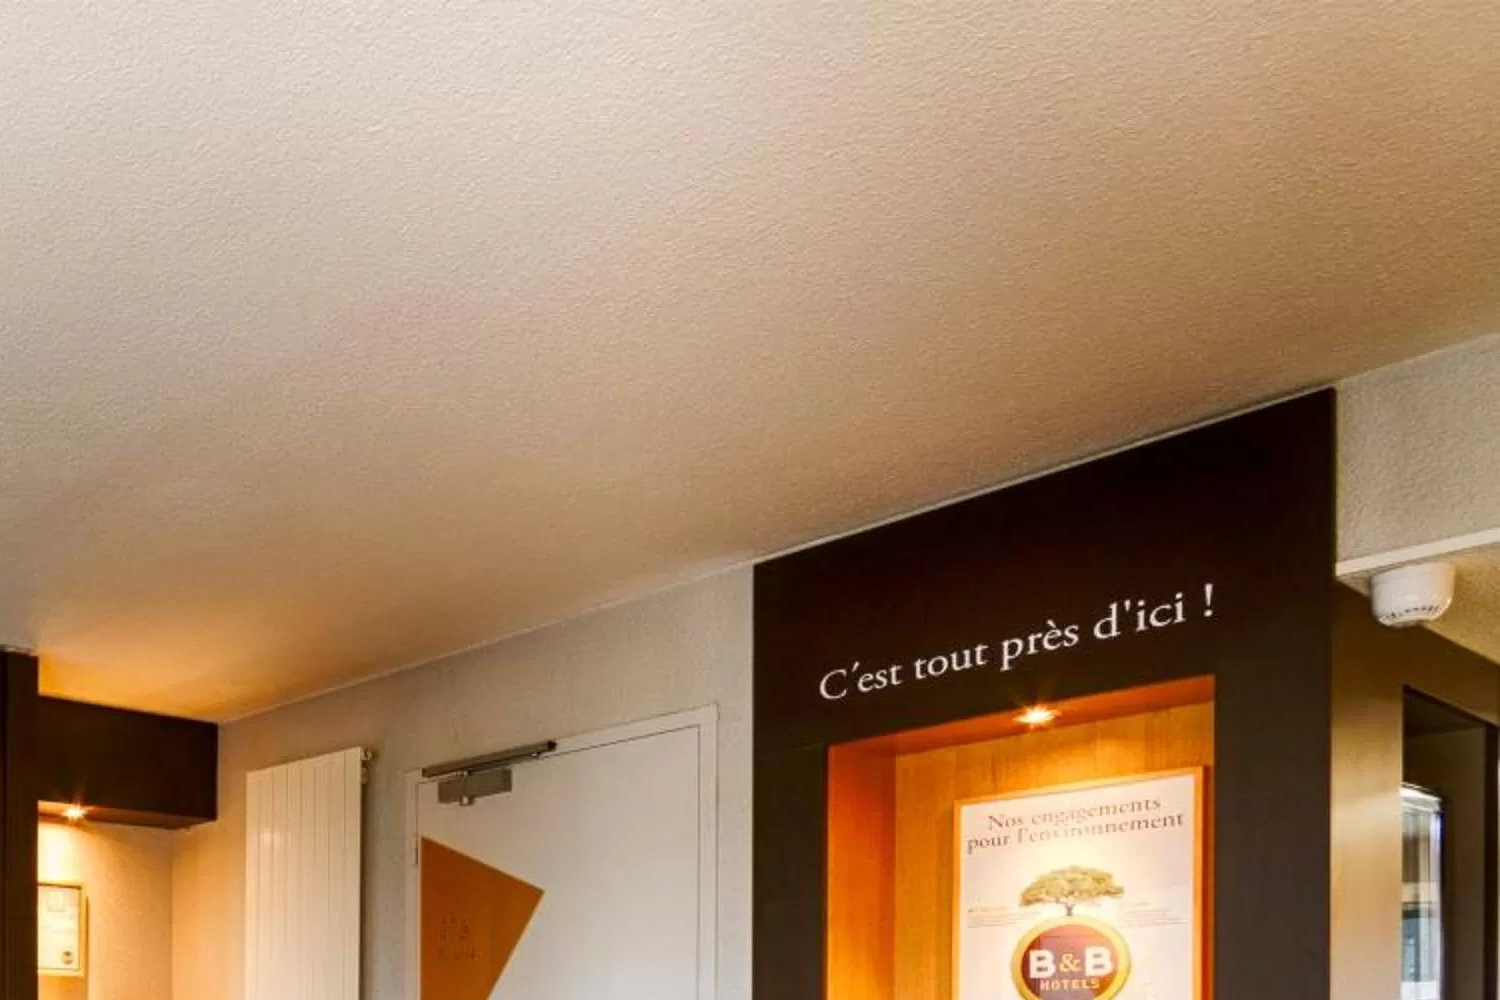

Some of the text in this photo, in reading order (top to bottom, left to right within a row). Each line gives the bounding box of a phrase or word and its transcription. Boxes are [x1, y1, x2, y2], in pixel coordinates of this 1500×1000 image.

[818, 661, 903, 701] C'est
[913, 643, 990, 681] tout
[1000, 619, 1080, 672] près
[987, 798, 1162, 831] Nos engagements
[966, 813, 1186, 855] pour l'environnement
[1029, 946, 1114, 979] B&B
[1040, 979, 1101, 992] HOTELS
